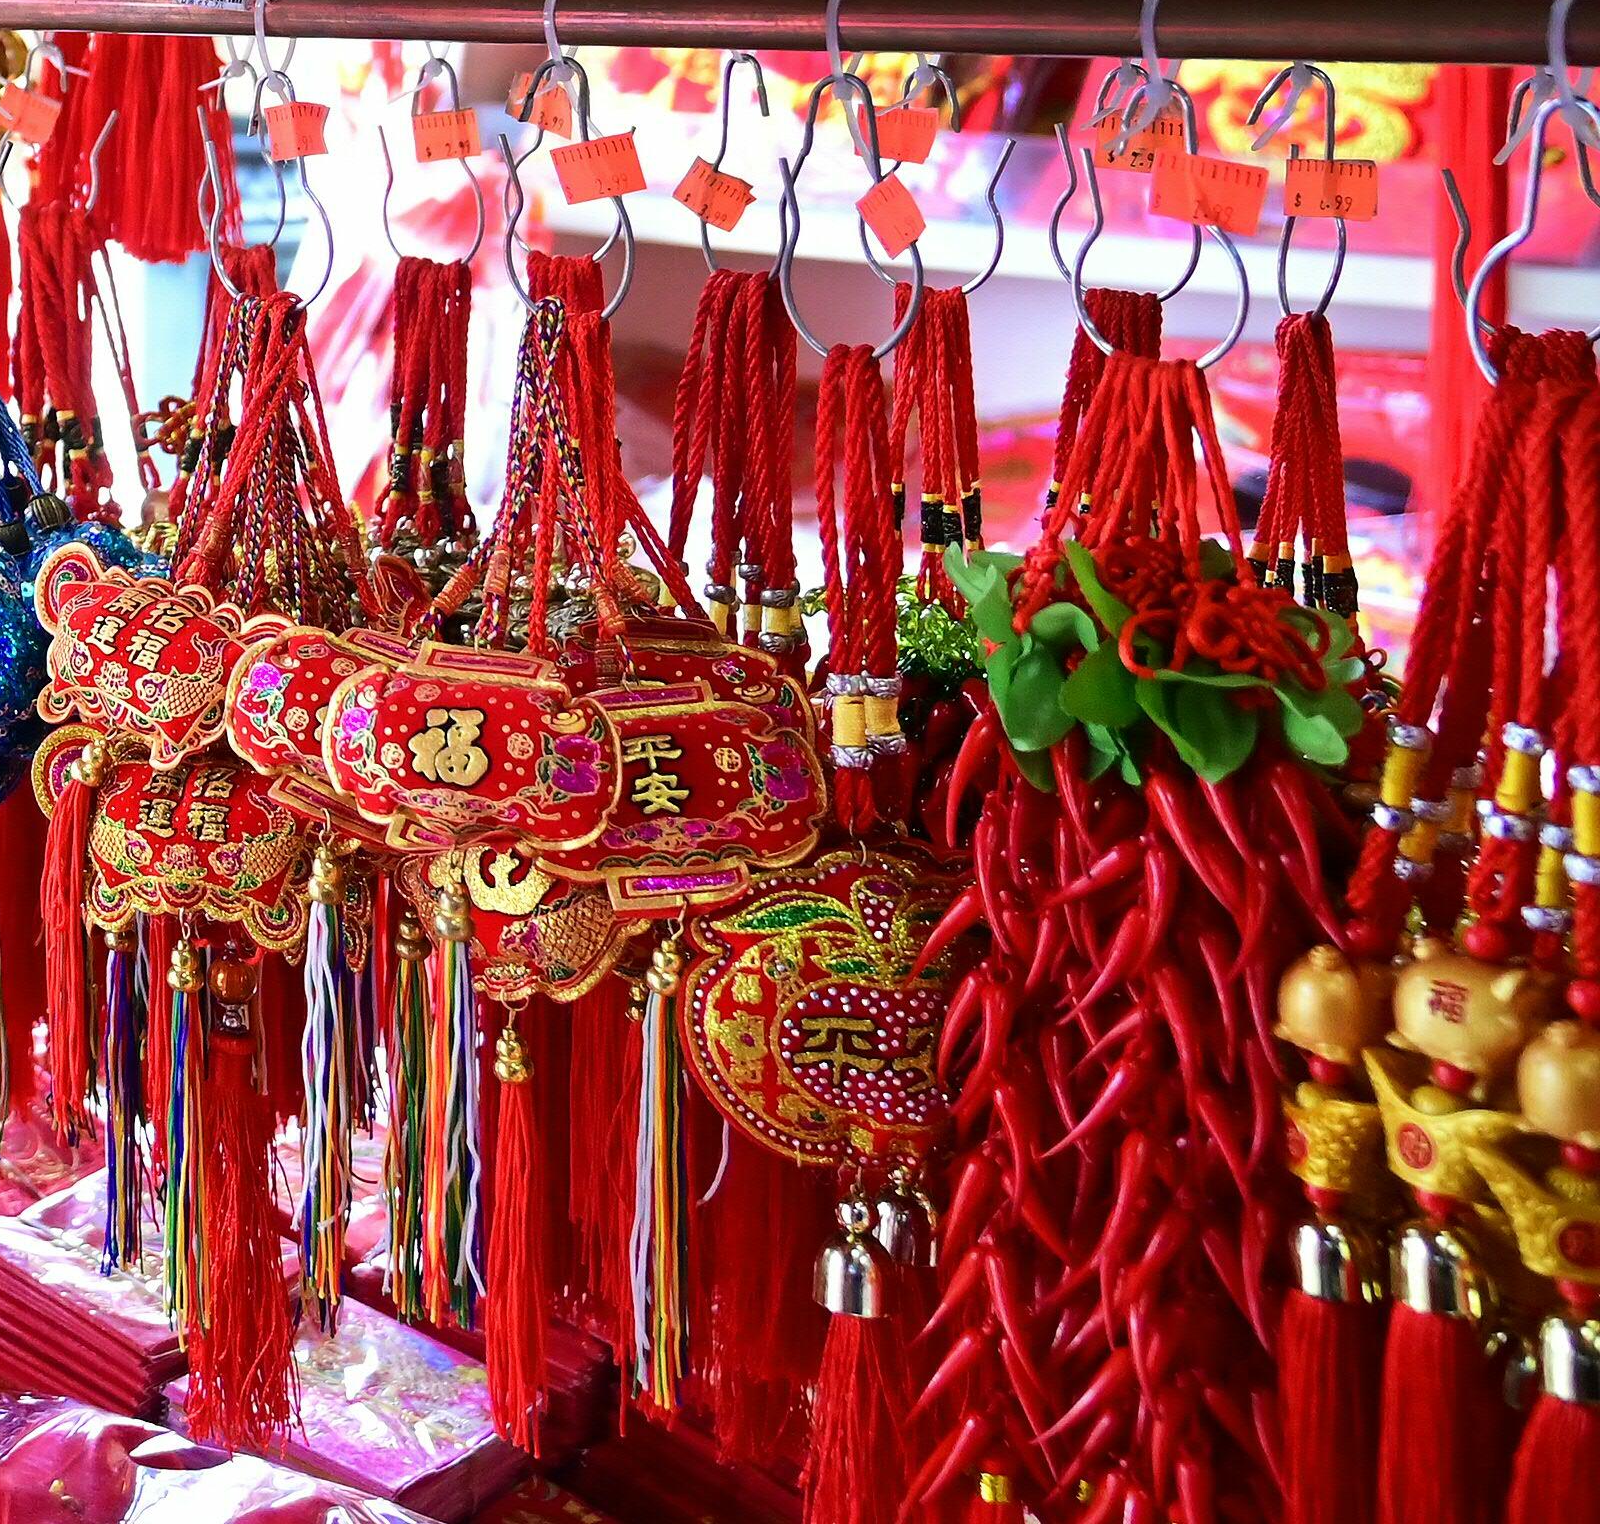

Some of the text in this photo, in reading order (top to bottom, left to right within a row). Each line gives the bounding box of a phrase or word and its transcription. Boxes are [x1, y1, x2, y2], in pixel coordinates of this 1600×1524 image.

[126, 602, 195, 673] 招福
[408, 708, 489, 786] 福
[622, 734, 690, 815] 平安
